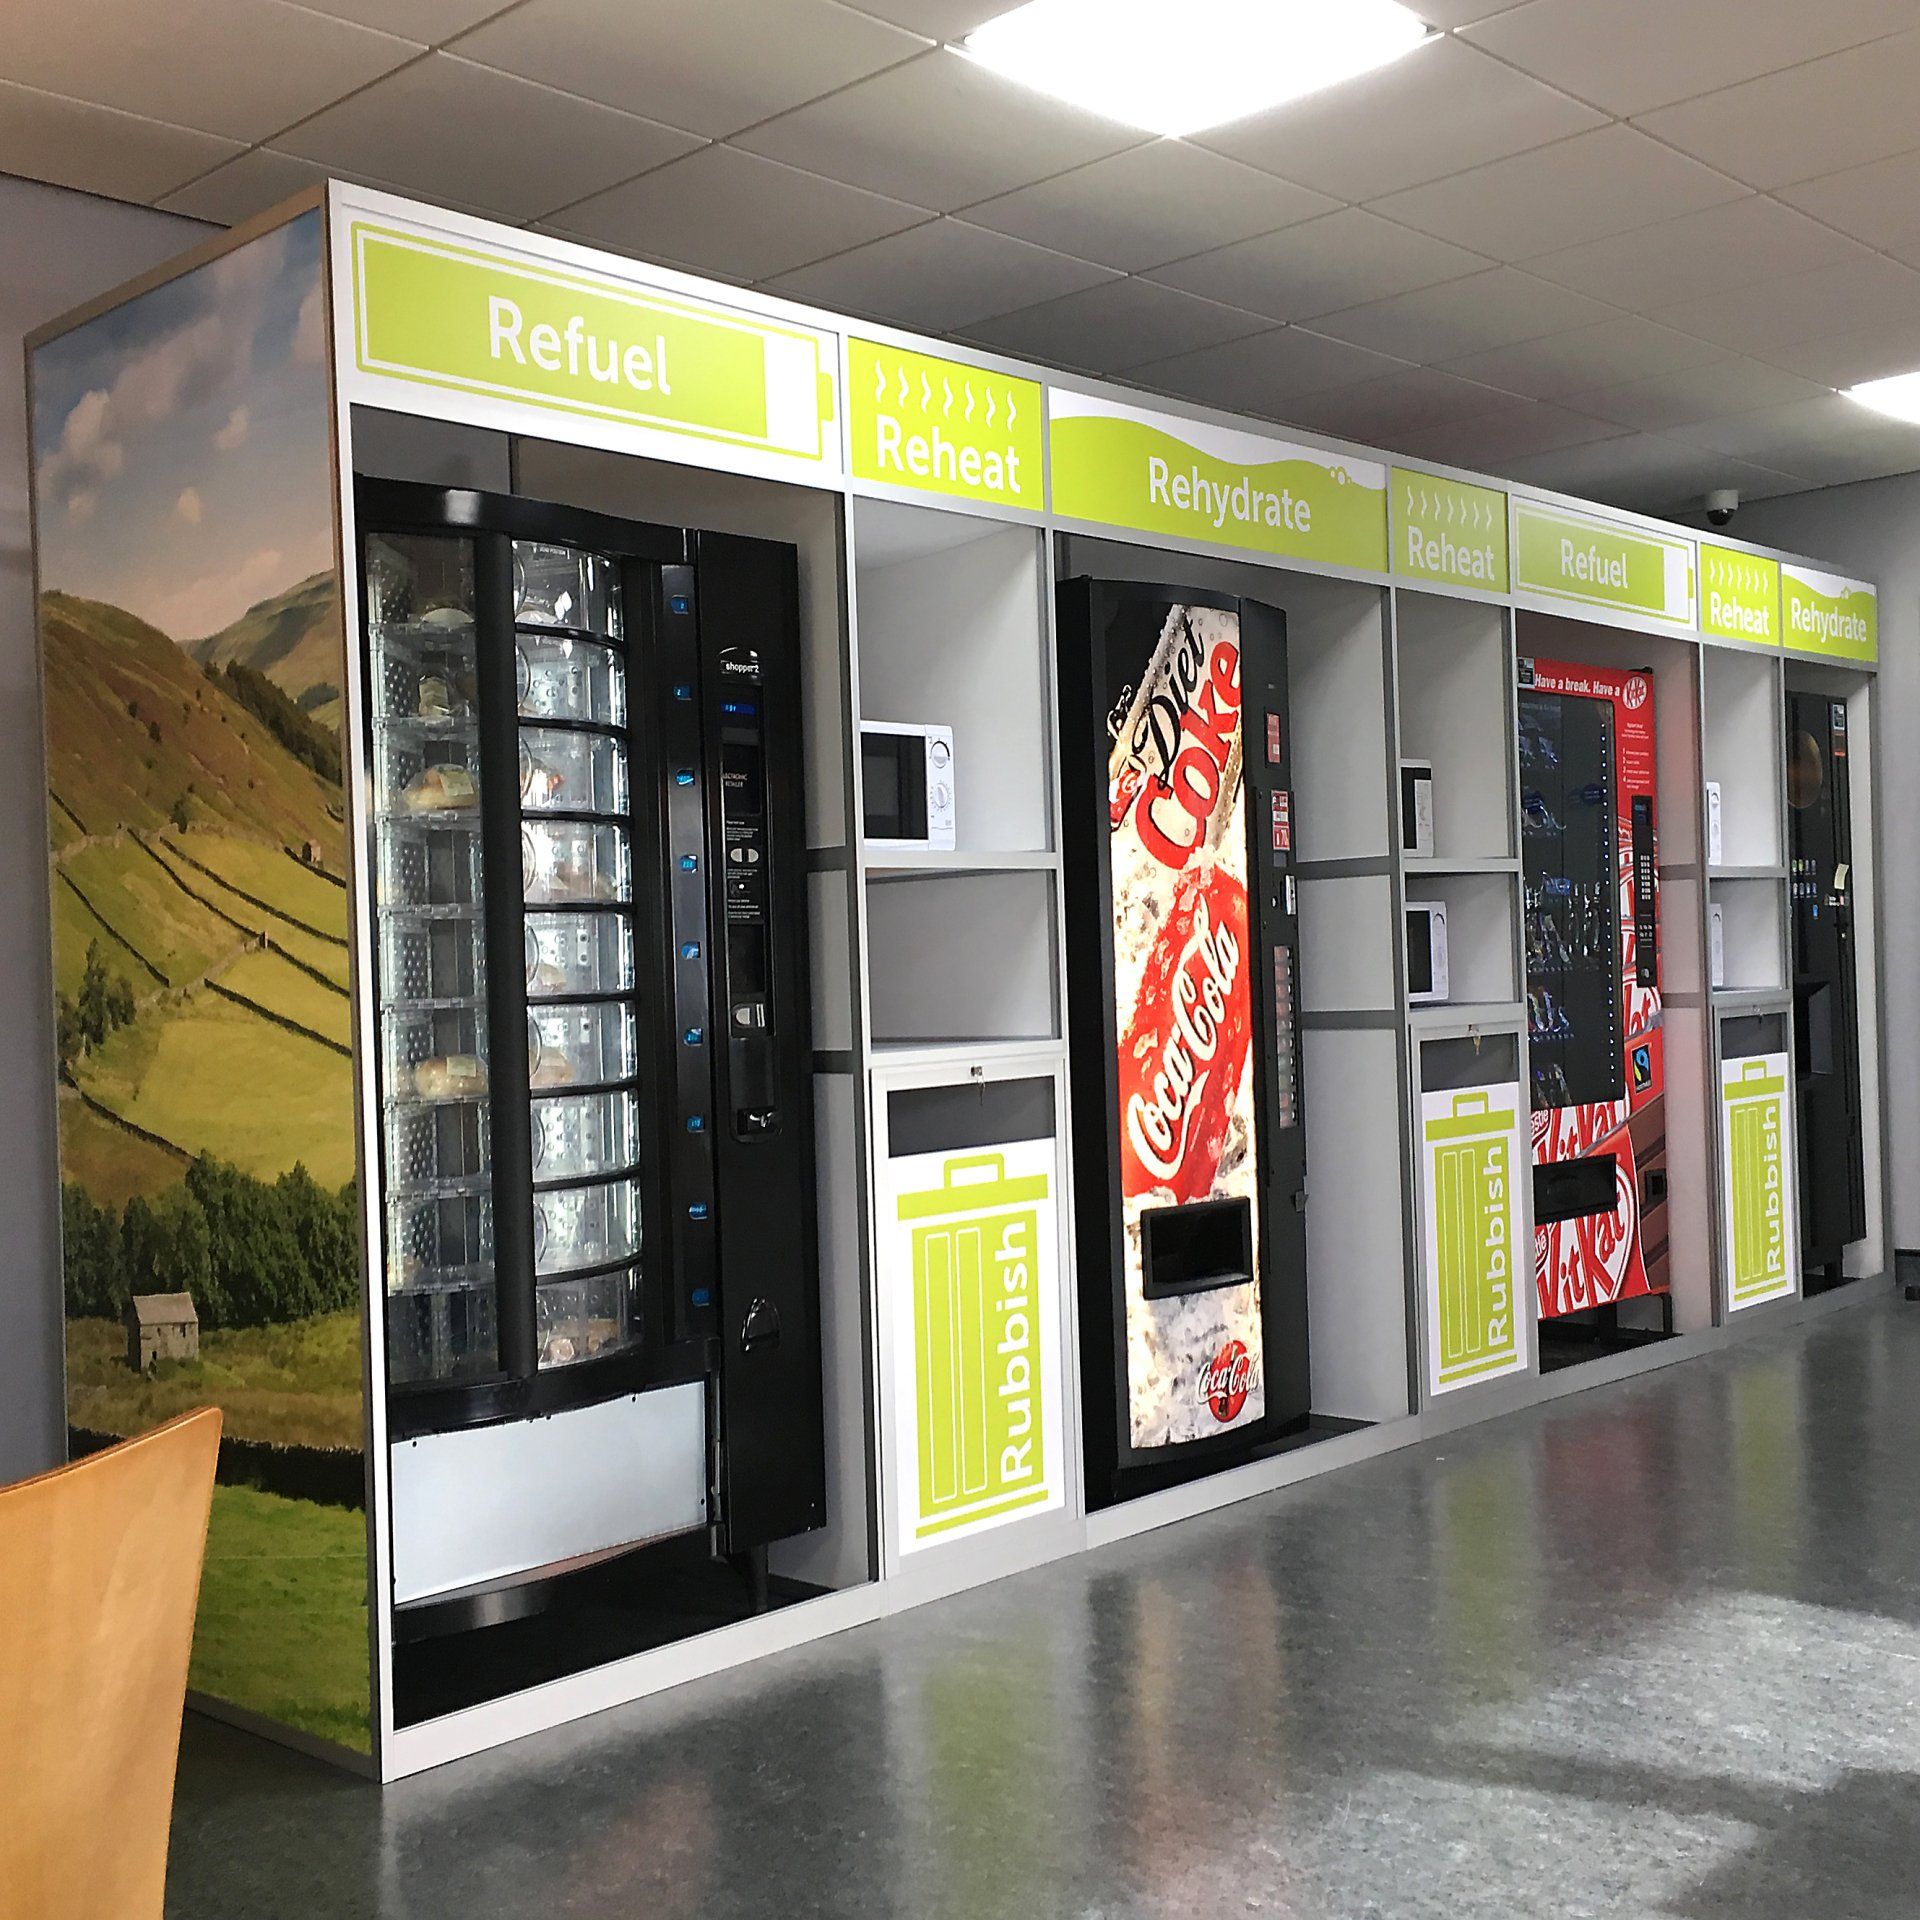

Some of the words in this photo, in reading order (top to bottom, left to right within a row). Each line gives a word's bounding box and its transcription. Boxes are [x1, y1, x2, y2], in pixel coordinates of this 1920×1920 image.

[488, 294, 671, 396] Refuel
[875, 415, 1022, 494] Reheat
[1149, 455, 1312, 533] Rehydrate
[1407, 525, 1495, 581] Reheat
[1560, 538, 1629, 589] Refuel
[1710, 592, 1770, 636] Reheat
[1790, 597, 1867, 643] Rehydrate
[1131, 617, 1205, 790] Diet
[1534, 673, 1556, 689] Have
[1557, 679, 1564, 690] a
[1565, 677, 1591, 693] break.
[1592, 680, 1613, 696] Have
[1613, 685, 1620, 697] a
[1135, 641, 1241, 870] Coke
[1762, 1105, 1781, 1273] Rubbish
[1482, 1145, 1508, 1347] Rubbish
[994, 1220, 1033, 1484] Rubbish
